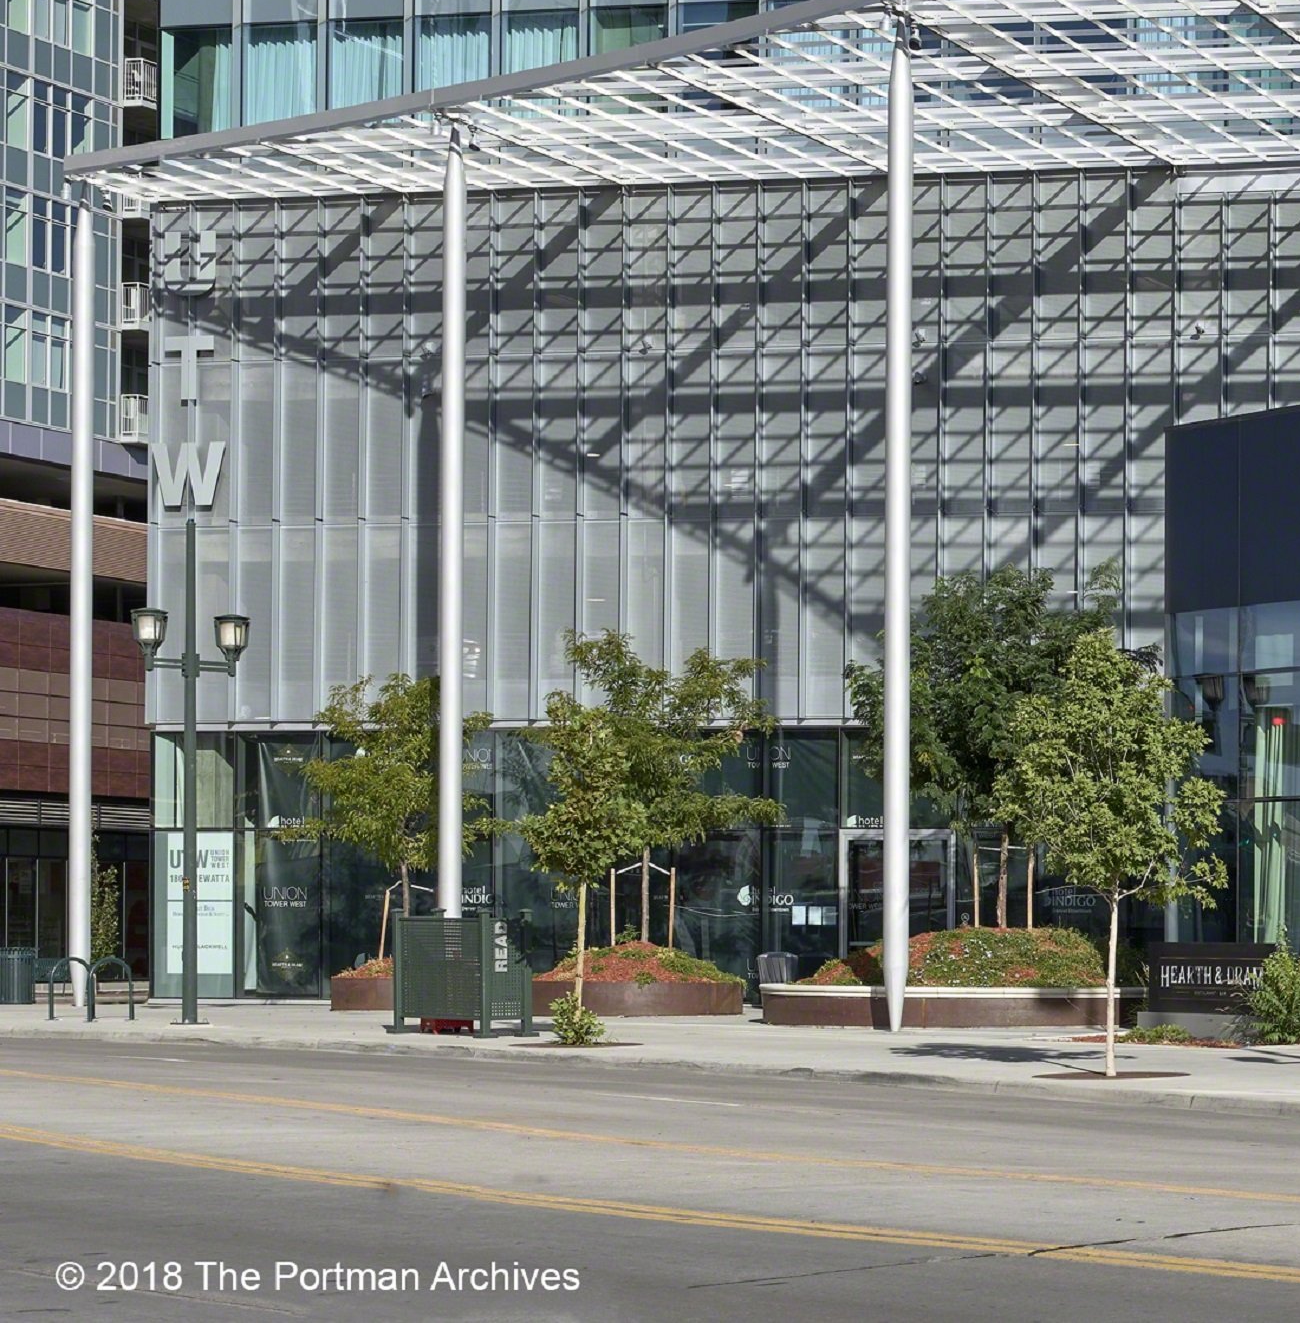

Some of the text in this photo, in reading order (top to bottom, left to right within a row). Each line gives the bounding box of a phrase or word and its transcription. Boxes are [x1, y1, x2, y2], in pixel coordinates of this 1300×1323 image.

[281, 815, 305, 825] hotel
[858, 816, 884, 825] hotel
[169, 849, 209, 869] UW
[198, 875, 230, 883] EWATTA
[263, 886, 308, 901] UNION
[1052, 895, 1097, 907] INDIGO
[494, 921, 508, 973] READ
[1160, 965, 1212, 988] HEARTH
[1214, 966, 1223, 985] &
